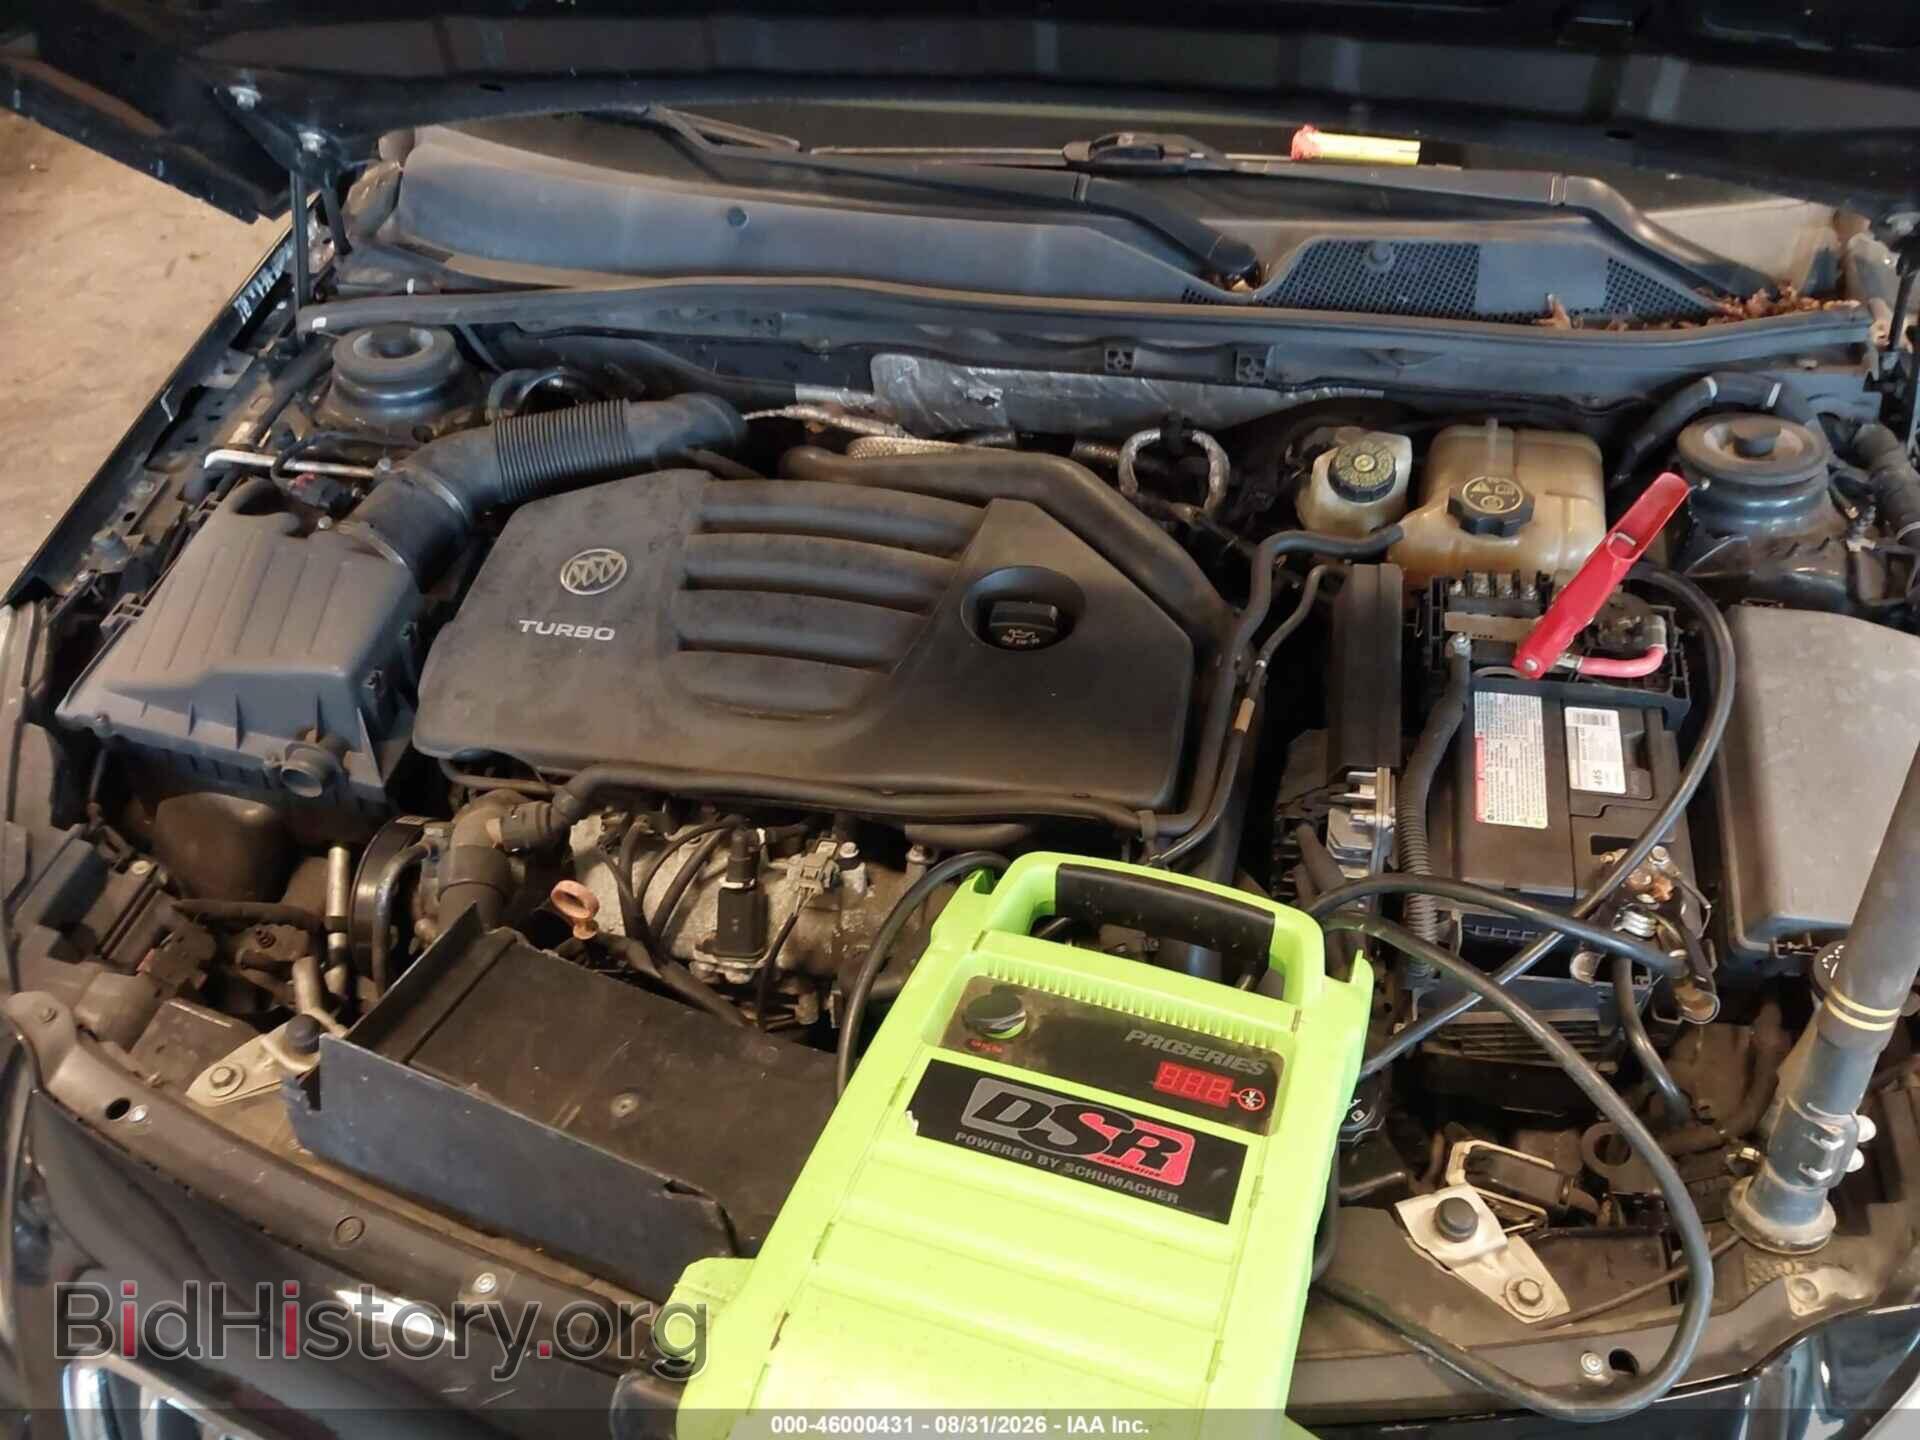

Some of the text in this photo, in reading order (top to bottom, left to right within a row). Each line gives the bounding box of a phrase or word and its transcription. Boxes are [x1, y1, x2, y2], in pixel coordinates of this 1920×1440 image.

[519, 620, 615, 640] TURBO
[954, 1131, 1180, 1204] POWERED BY SCHUMACHER
[971, 1091, 1184, 1171] DSR
